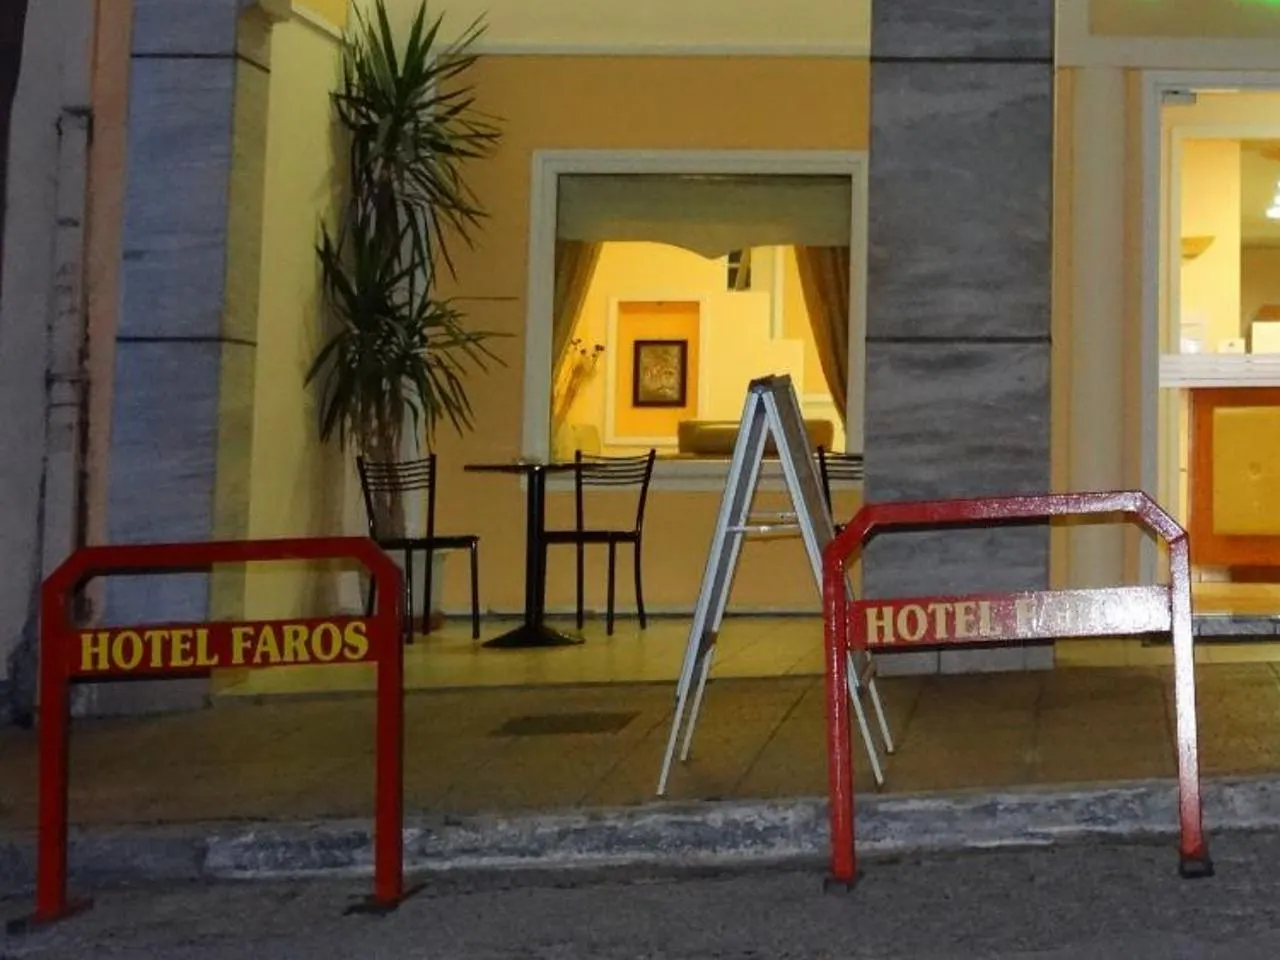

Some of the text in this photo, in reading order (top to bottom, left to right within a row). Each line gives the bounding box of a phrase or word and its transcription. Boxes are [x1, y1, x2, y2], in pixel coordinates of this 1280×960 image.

[866, 600, 1001, 644] HOTEL
[81, 622, 369, 671] HOTEL FAROS
